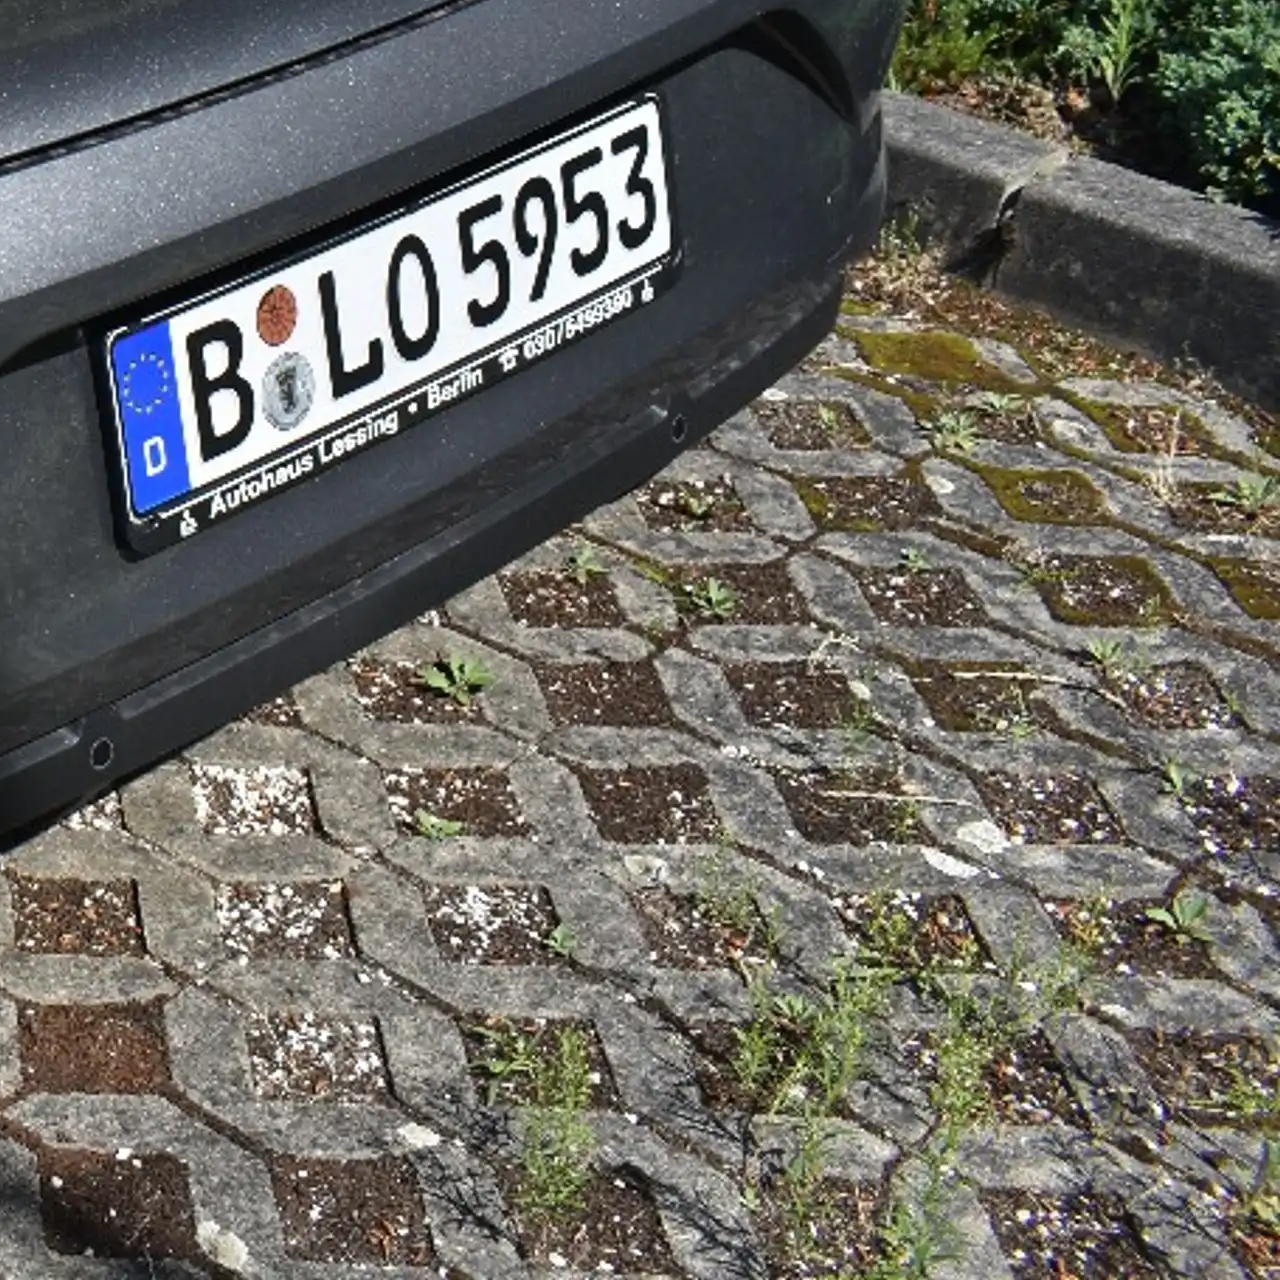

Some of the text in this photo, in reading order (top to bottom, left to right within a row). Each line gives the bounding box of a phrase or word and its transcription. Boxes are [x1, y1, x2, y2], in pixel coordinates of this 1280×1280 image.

[185, 124, 657, 463] B LO 5953
[144, 436, 168, 476] D
[210, 453, 314, 519] Autohaus
[318, 412, 399, 465] Lessing
[426, 366, 484, 410] Berlin
